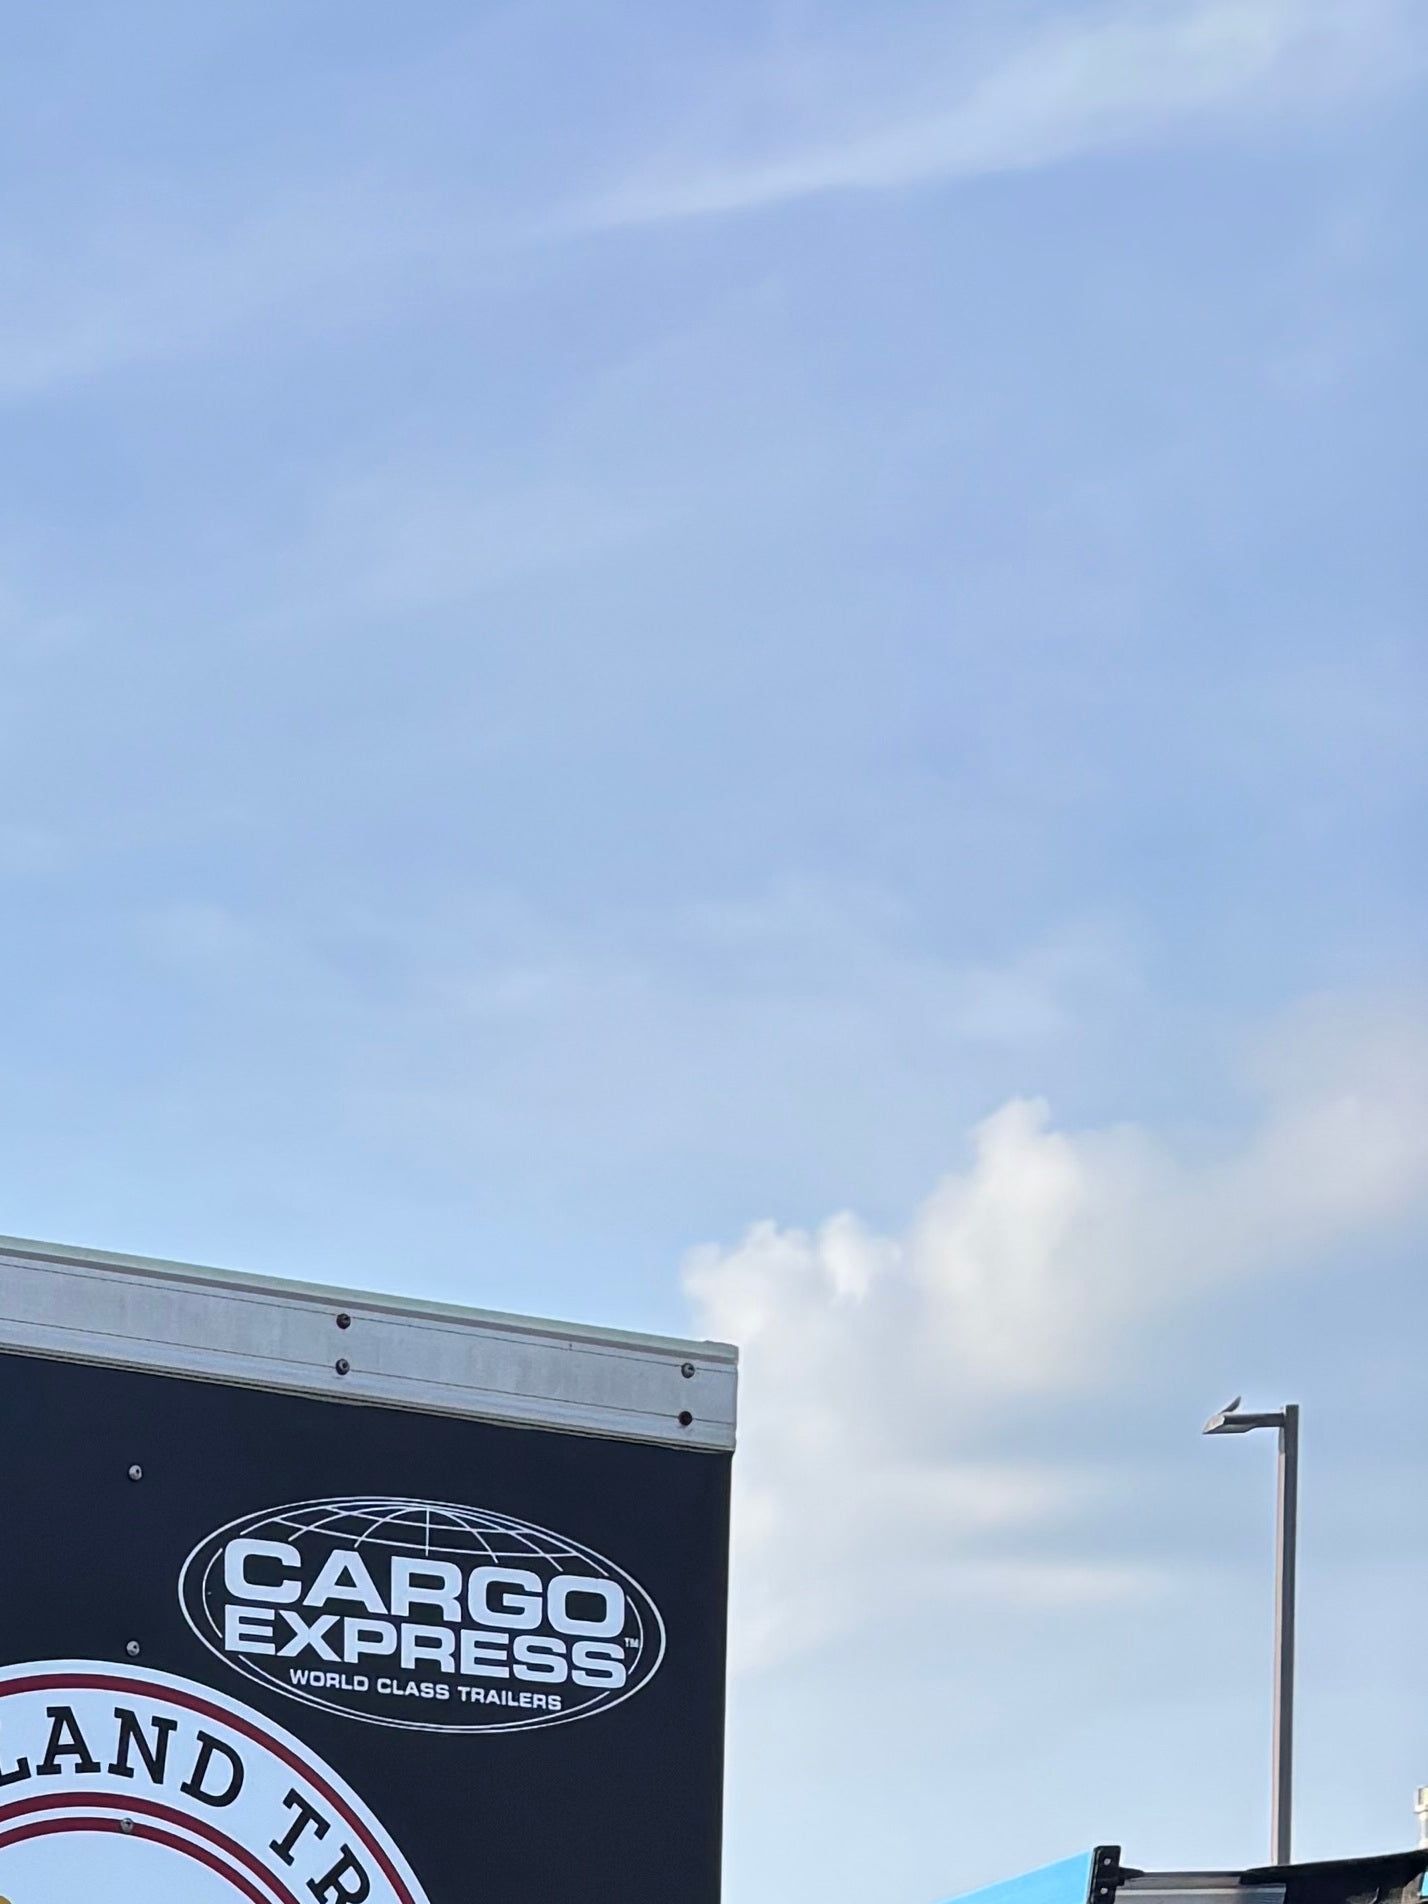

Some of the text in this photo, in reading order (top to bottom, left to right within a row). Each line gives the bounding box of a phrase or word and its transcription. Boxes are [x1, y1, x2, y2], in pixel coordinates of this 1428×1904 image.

[224, 1538, 625, 1638] CARGO
[225, 1604, 626, 1689] EXPRESS
[289, 1669, 562, 1711] WORLD CLASS TRAILERS
